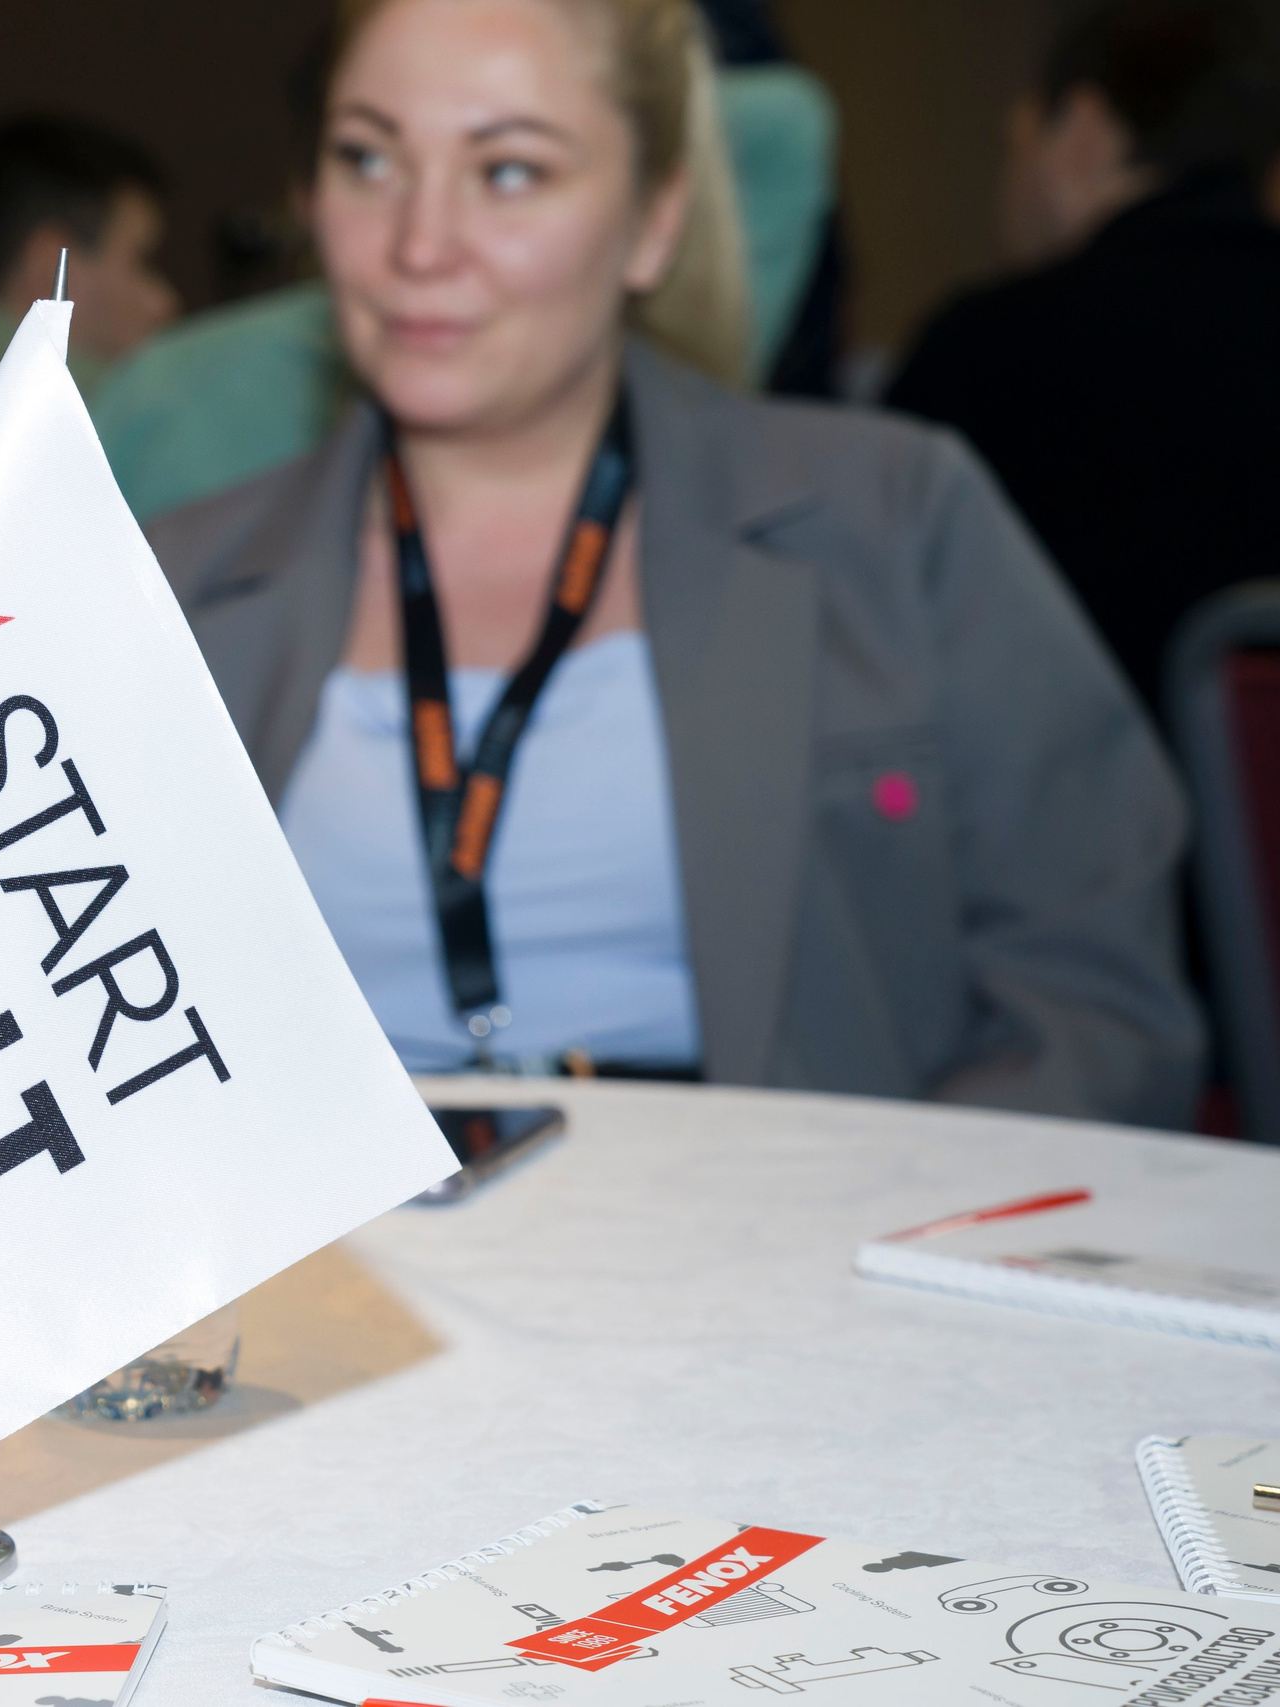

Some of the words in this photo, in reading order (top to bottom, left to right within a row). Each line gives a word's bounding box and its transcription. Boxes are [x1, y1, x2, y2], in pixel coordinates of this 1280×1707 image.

[40, 1603, 78, 1615] Brake
[79, 1611, 128, 1624] System
[641, 1546, 774, 1616] FENOX
[1122, 1627, 1275, 1707] РОИЗВОДСТВО
